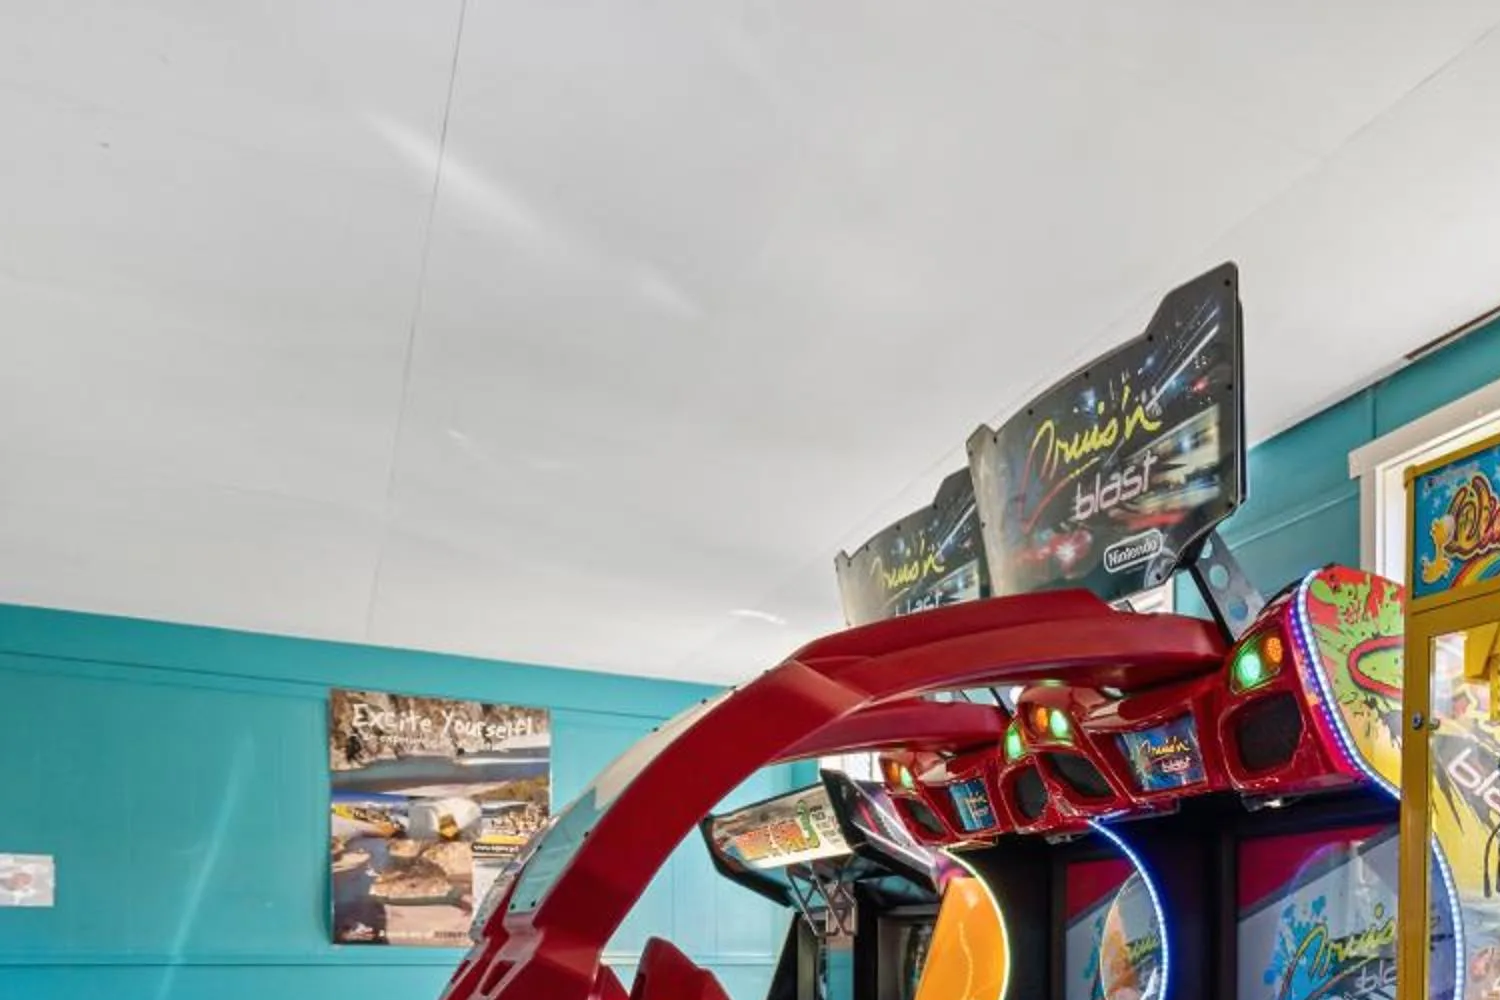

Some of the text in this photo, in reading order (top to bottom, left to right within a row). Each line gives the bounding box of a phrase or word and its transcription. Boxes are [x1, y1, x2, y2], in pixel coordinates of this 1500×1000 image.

[1071, 449, 1158, 522] blast
[1108, 536, 1158, 567] Nintendo
[352, 703, 432, 733] Excite
